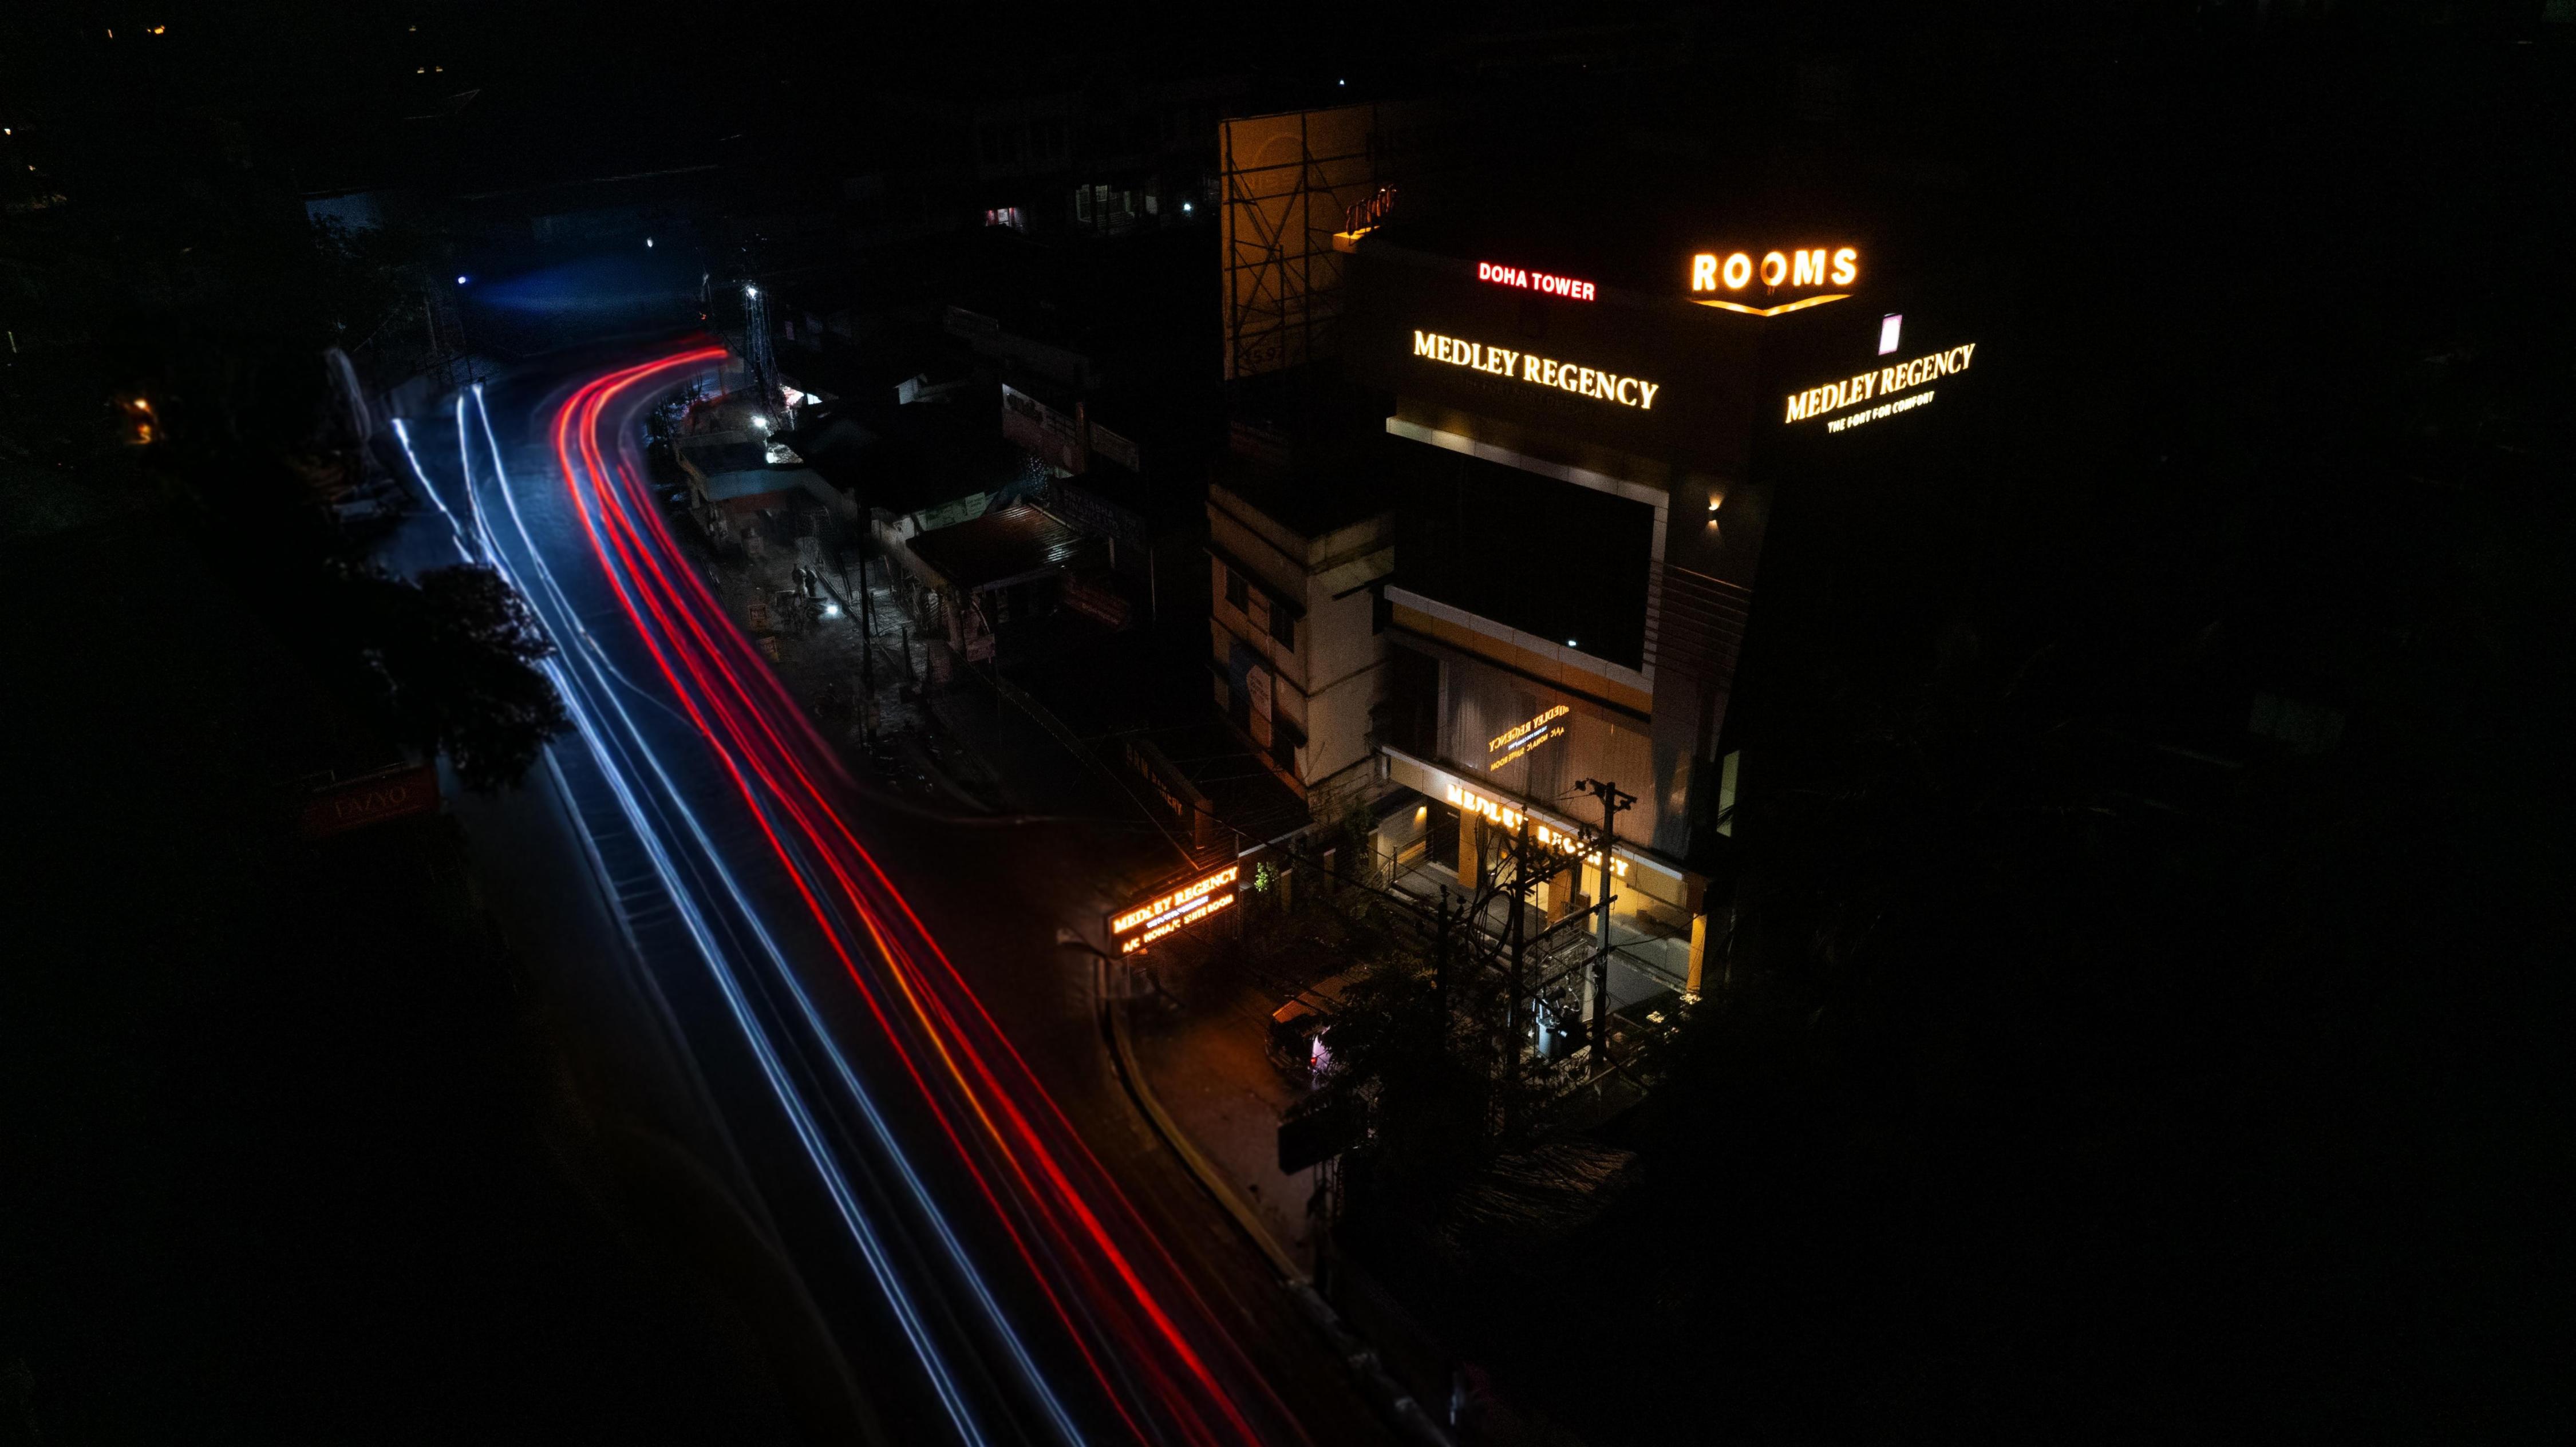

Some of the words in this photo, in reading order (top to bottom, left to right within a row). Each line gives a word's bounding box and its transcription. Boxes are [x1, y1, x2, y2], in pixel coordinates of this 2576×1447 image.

[1478, 262, 1528, 288] DOHA
[1531, 272, 1595, 301] TOWER
[1690, 247, 1859, 291] ROOMS
[1414, 330, 1519, 377] MEDLEY
[1523, 355, 1659, 409] REGENCY
[1785, 371, 1878, 424] MEDLEY
[1879, 343, 1976, 395] REGENCY
[1828, 418, 1846, 433] THE
[1847, 410, 1871, 428] FORT
[1872, 405, 1892, 420] FOR
[1892, 392, 1934, 414] COMFORT
[1113, 895, 1174, 934] MEDLEY
[1174, 867, 1238, 907] REGENCY
[1123, 938, 1141, 953] A/C
[1207, 894, 1234, 913] ROOM
